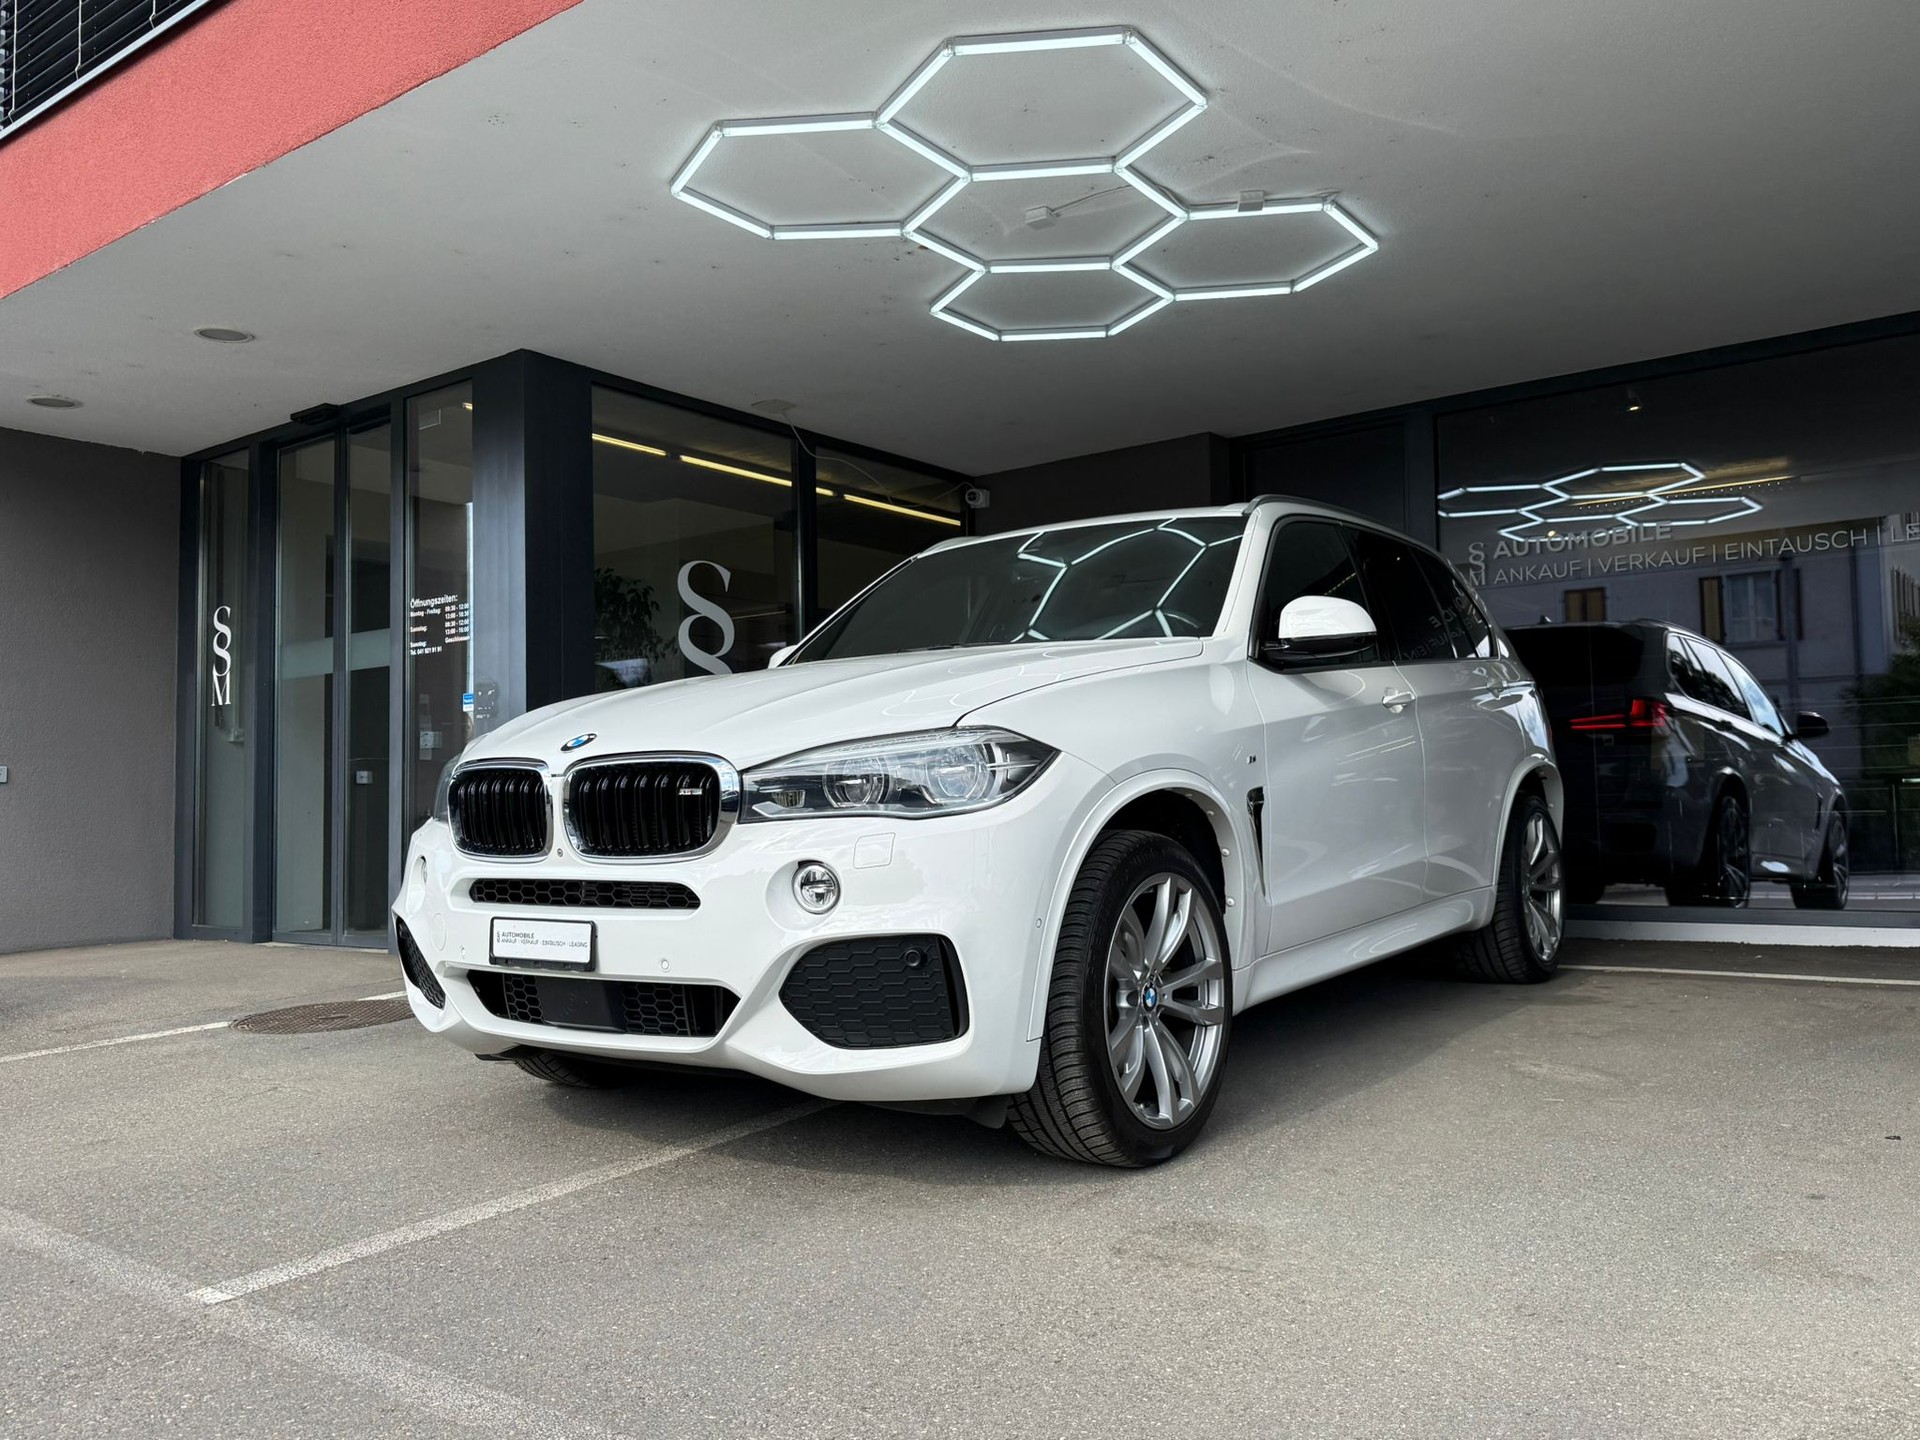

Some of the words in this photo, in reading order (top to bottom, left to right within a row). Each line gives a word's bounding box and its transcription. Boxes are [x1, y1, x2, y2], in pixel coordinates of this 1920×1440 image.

[1493, 521, 1672, 559] AUTOMOBILE
[1494, 560, 1582, 585] ANKAUF
[1598, 546, 1706, 574] VERKAUF
[1724, 528, 1868, 561] EINTAUSCH
[501, 931, 535, 939] AUTOMOBILE
